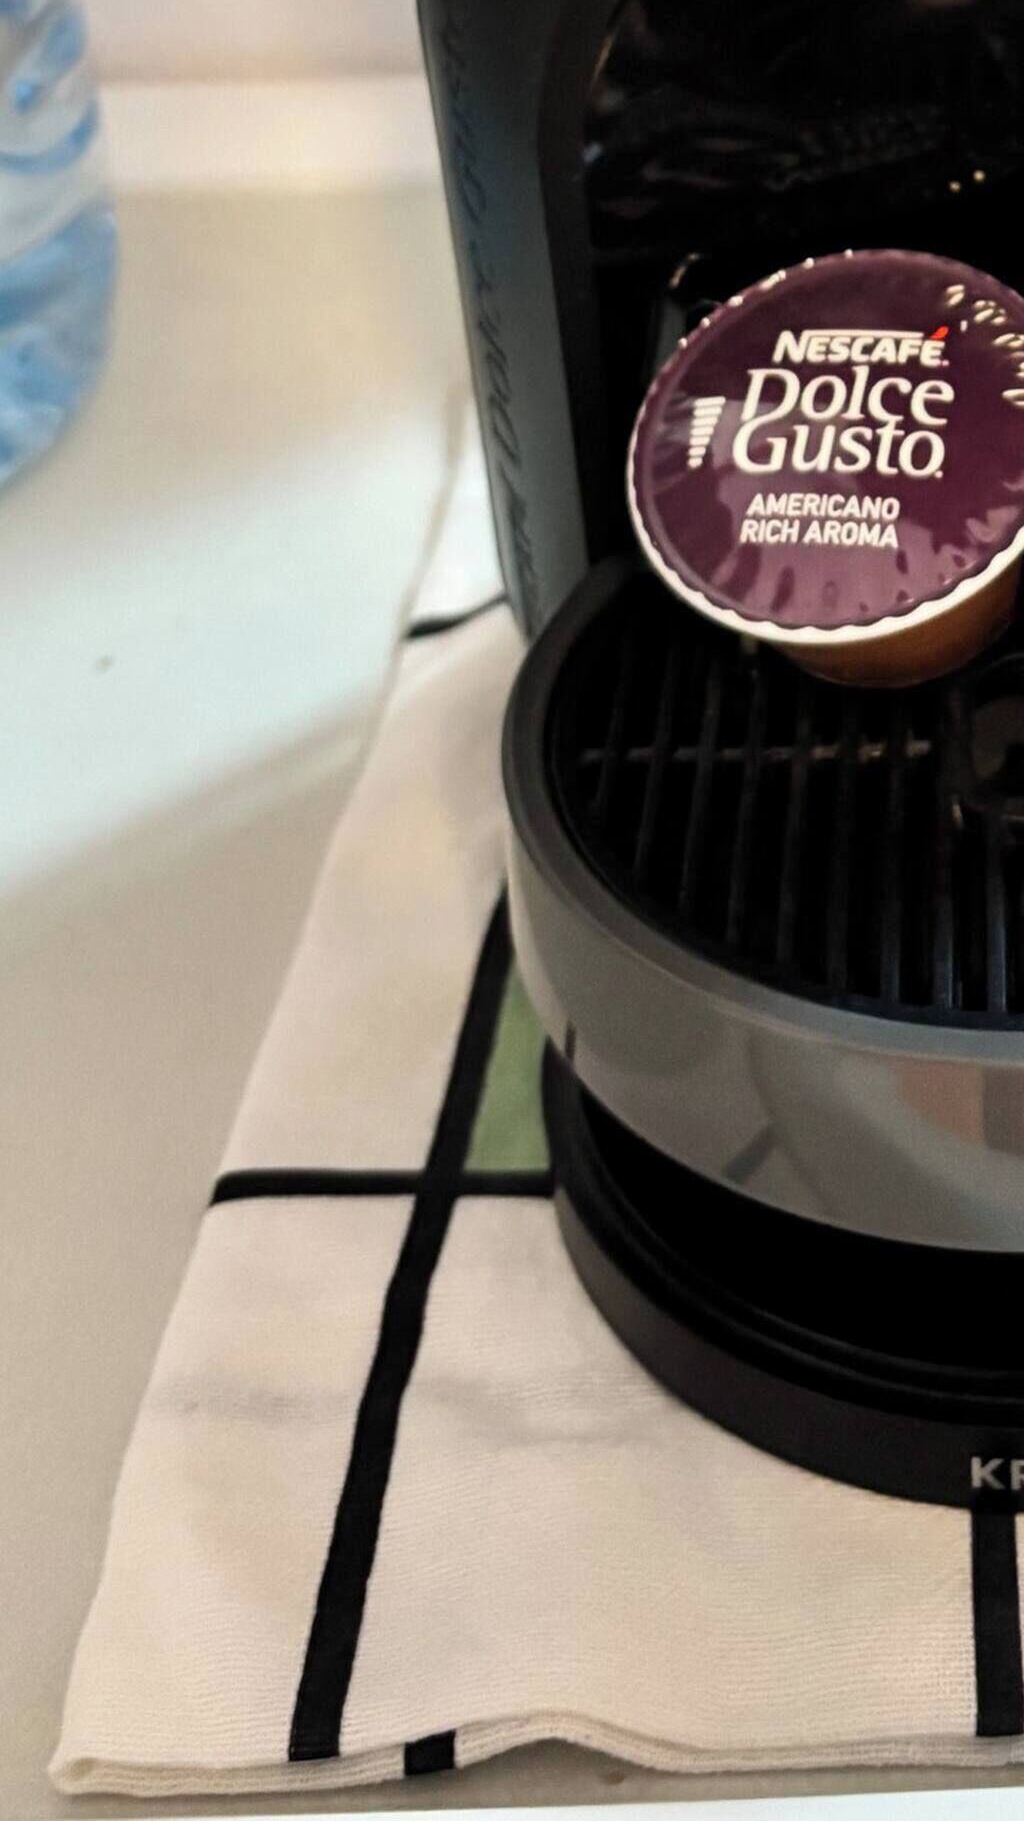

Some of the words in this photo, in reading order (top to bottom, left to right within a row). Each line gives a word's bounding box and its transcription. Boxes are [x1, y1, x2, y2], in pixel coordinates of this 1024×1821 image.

[773, 326, 949, 367] NESCAFÉ
[740, 365, 955, 425] Dolce
[732, 415, 946, 478] Gusto
[745, 493, 900, 521] AMERICANO
[739, 518, 799, 544] RICH
[804, 520, 899, 548] AROMA
